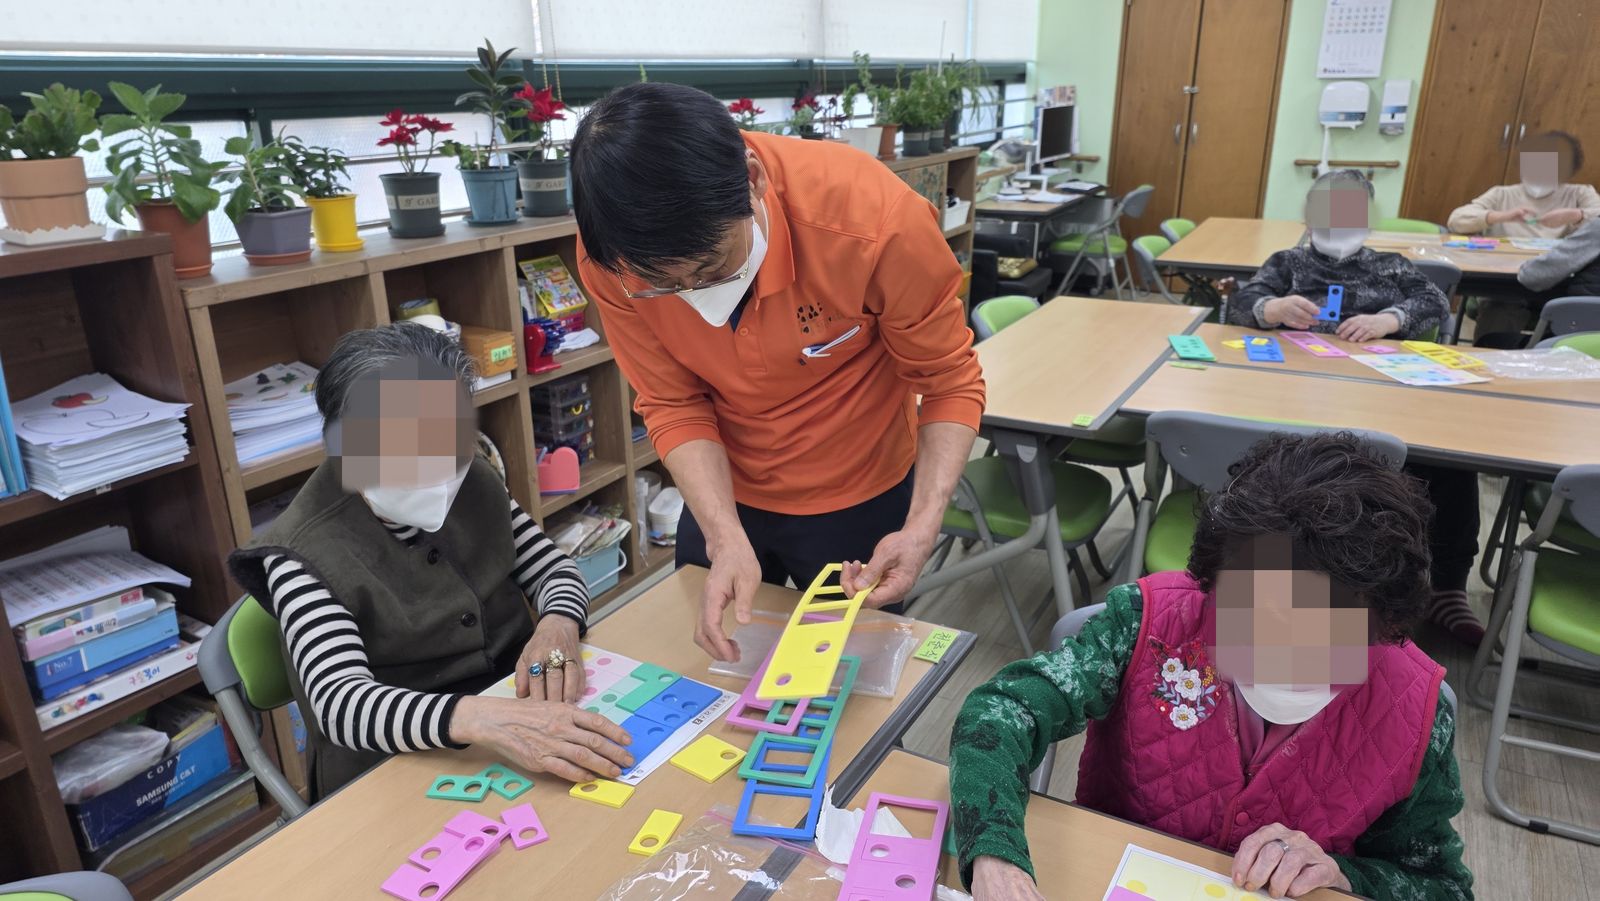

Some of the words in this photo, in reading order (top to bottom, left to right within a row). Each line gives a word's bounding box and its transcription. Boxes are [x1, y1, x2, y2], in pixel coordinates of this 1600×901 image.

[146, 754, 181, 780] COPY
[136, 776, 179, 807] SAMSUNG
[179, 765, 197, 781] C&T
